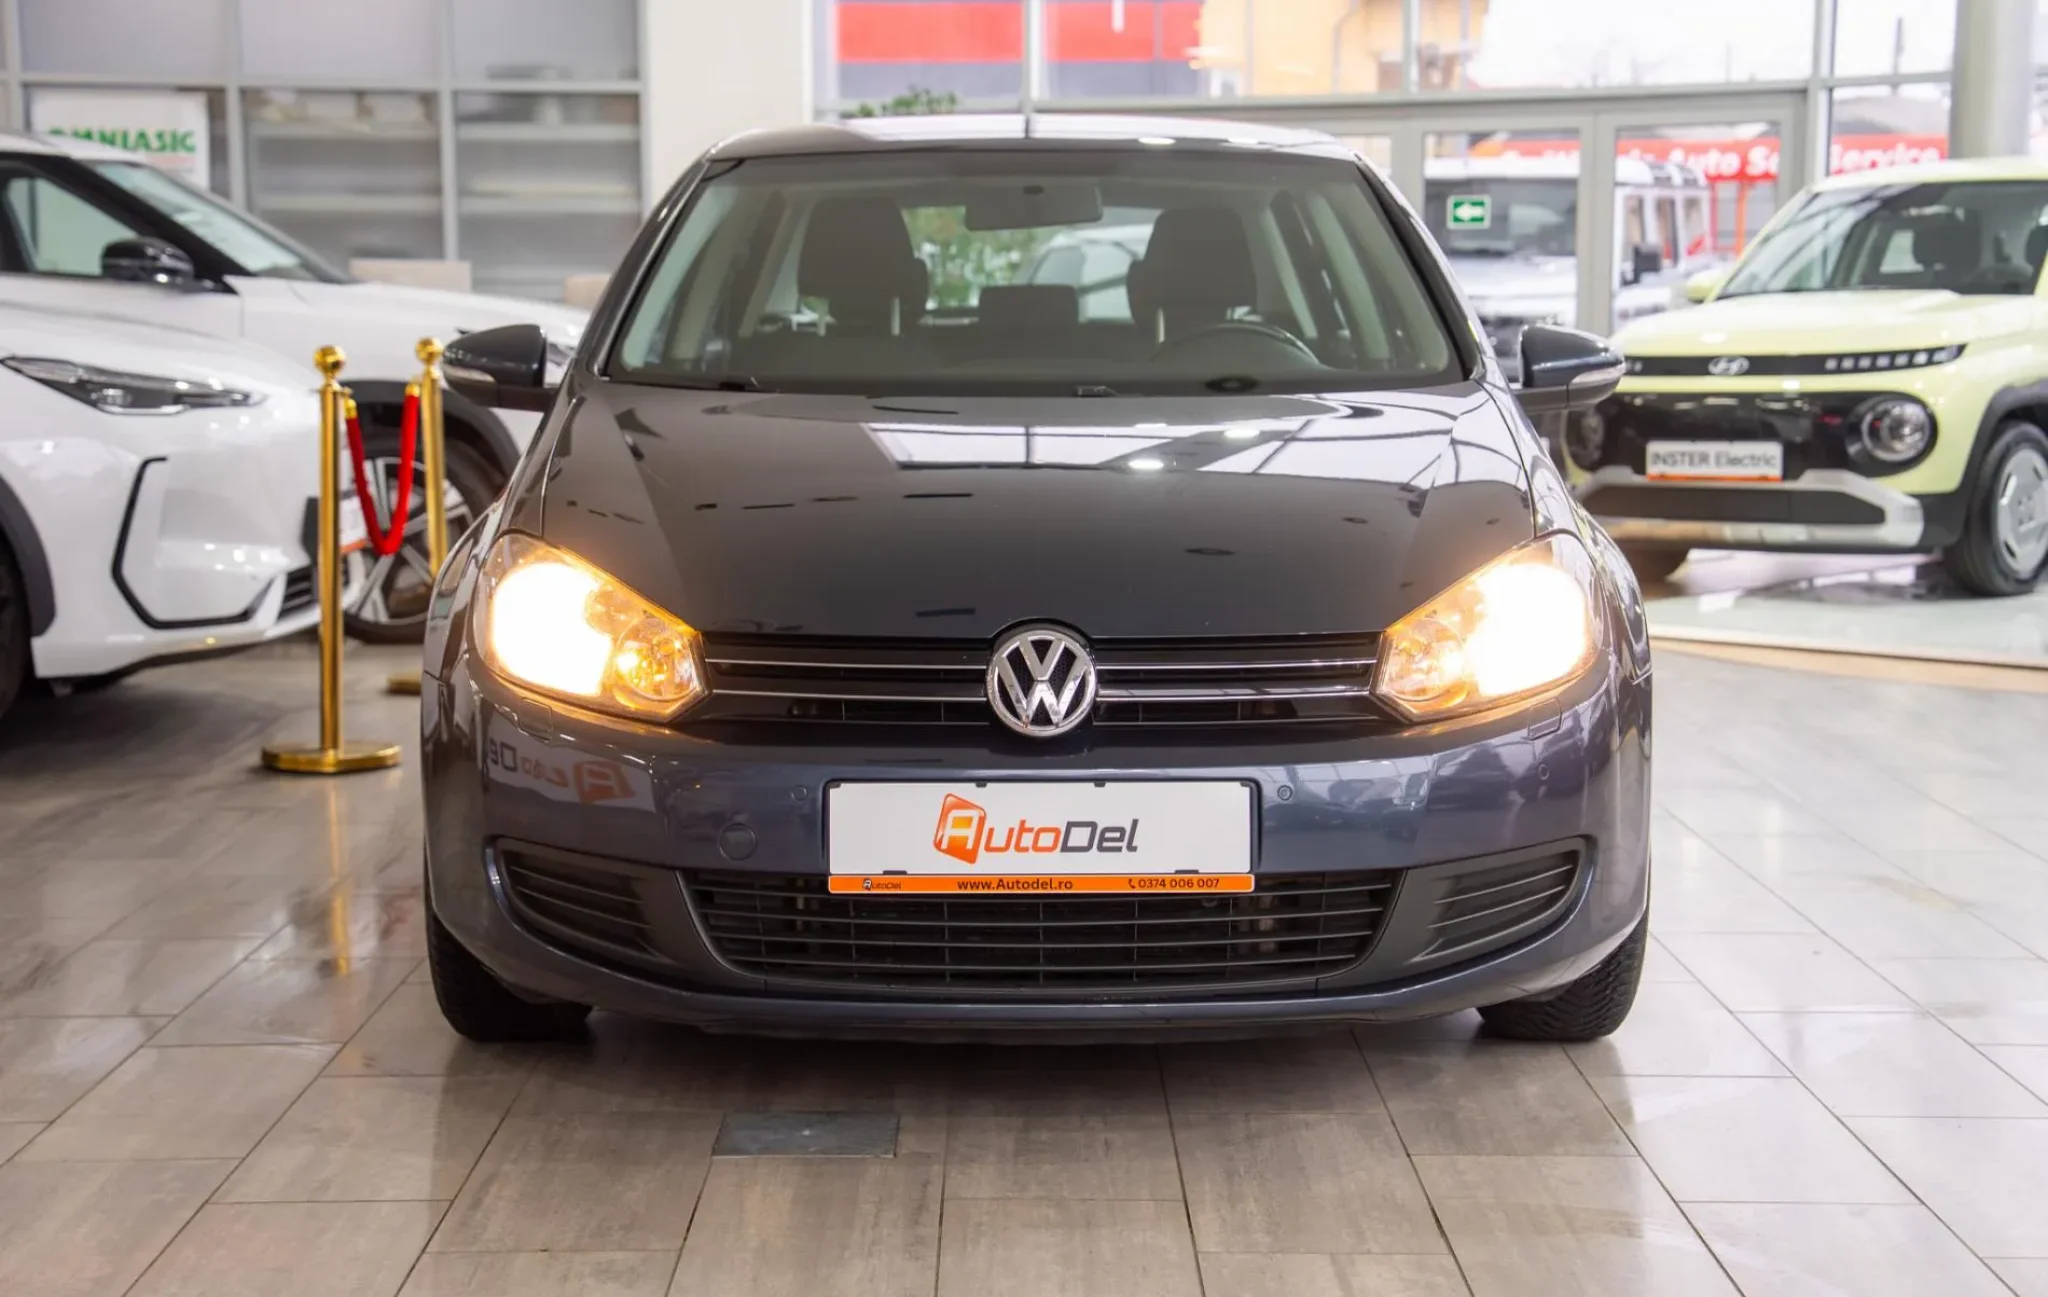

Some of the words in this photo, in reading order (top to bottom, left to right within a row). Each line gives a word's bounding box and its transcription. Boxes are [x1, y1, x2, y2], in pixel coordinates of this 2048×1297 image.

[1651, 451, 1710, 468] INSTER
[1714, 451, 1777, 468] Electric
[937, 806, 1139, 855] AutoDel
[957, 878, 1073, 891] www.Autodel.ro
[1138, 879, 1166, 889] 0374
[1169, 879, 1194, 889] 006
[1197, 878, 1220, 889] 007
